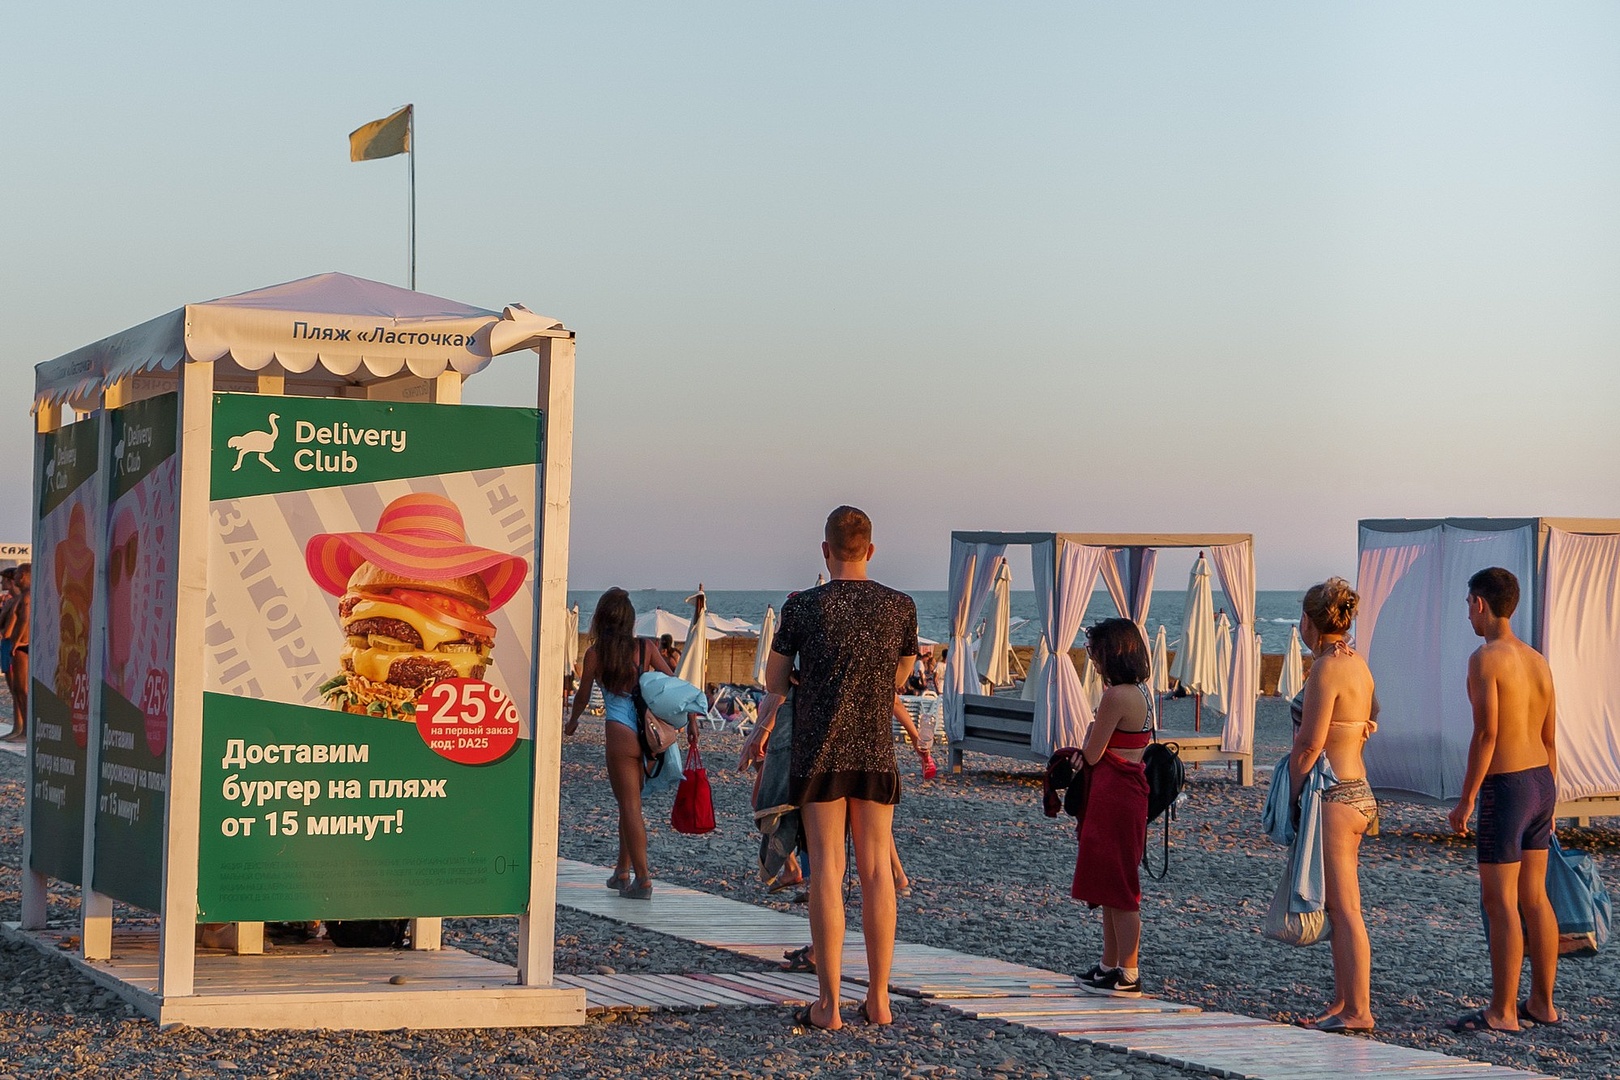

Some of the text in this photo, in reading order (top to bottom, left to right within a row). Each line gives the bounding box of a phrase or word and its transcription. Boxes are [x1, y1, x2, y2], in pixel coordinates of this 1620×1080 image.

[293, 321, 477, 347] Пляж «Ласточка»
[128, 424, 153, 448] Delivery
[295, 420, 406, 452] Delivery
[294, 448, 358, 473] Club
[1, 545, 29, 555] САЖ
[416, 684, 519, 724] -25%
[431, 725, 514, 737] на первый заказ
[222, 739, 369, 769] Доставим
[430, 738, 489, 751] код: DA25
[222, 774, 447, 806] бургер на пляж
[221, 809, 404, 841] от 15 минут!
[494, 855, 520, 875] 0+
